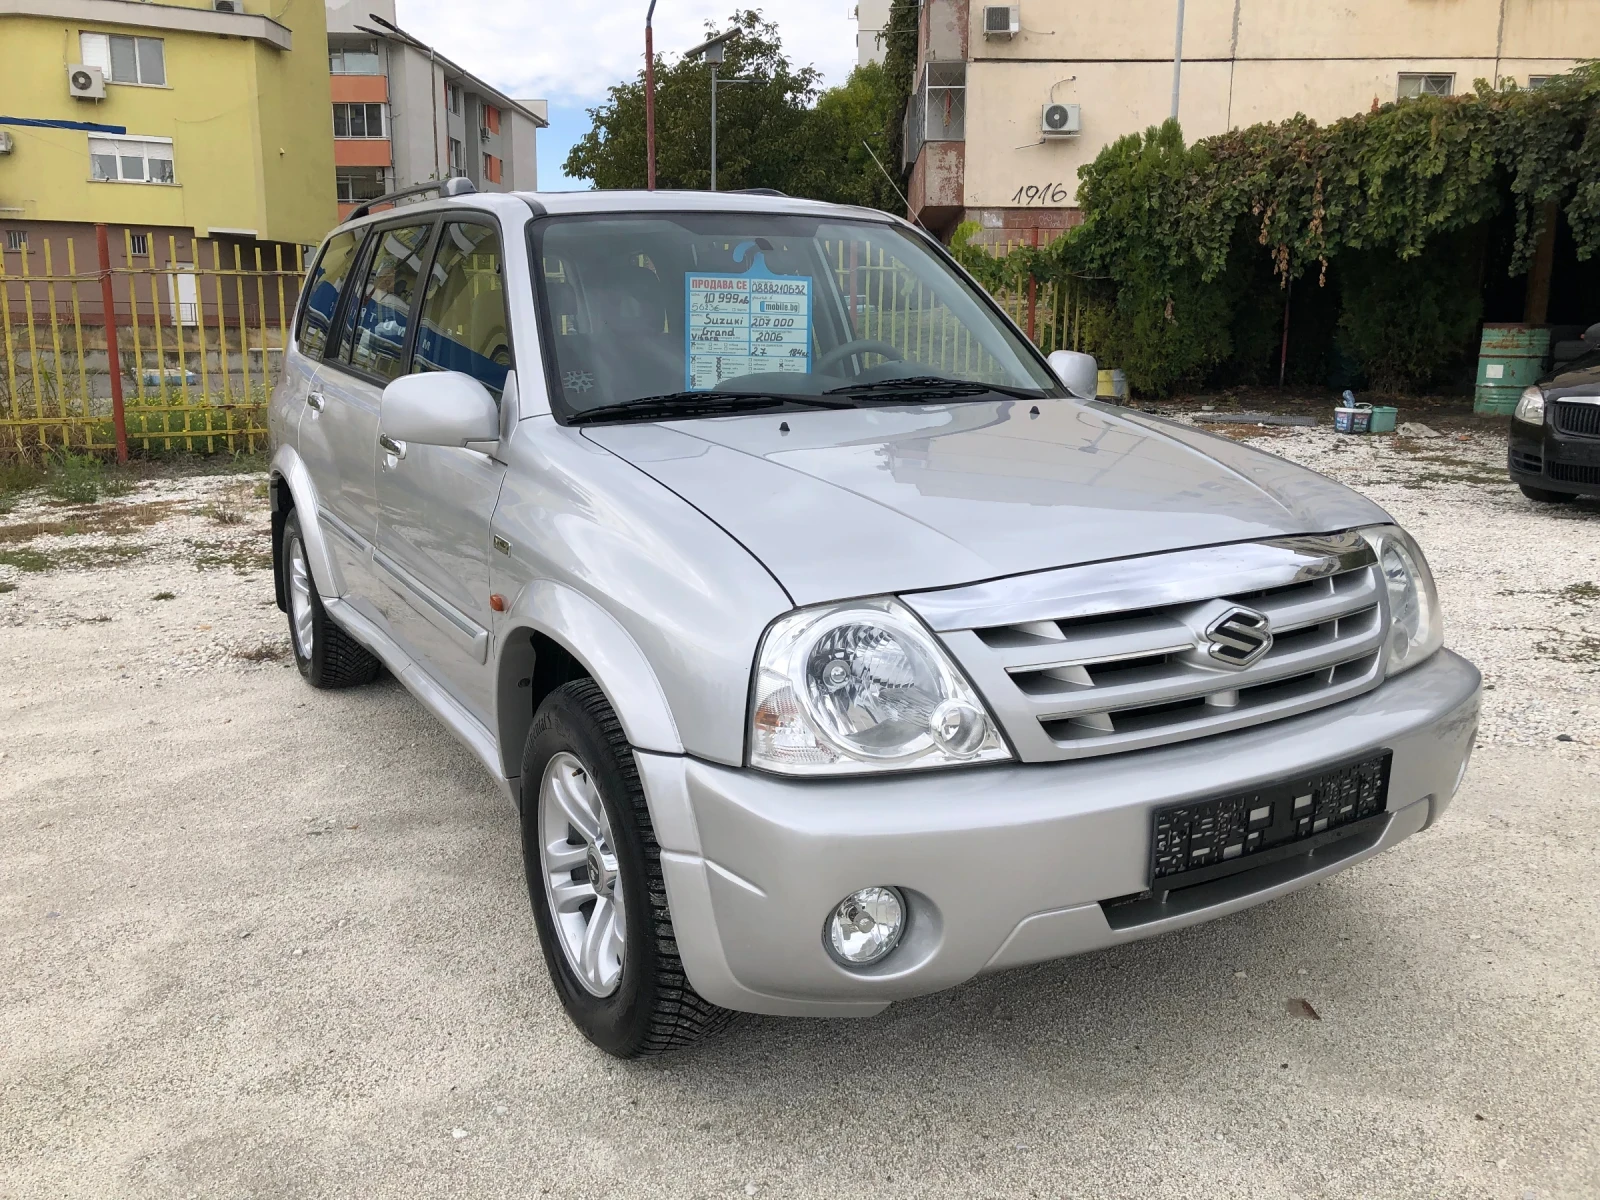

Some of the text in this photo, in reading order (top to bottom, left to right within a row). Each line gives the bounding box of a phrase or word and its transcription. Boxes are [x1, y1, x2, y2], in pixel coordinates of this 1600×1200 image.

[1011, 182, 1068, 206] 1916
[691, 279, 748, 290] ПРОДАВА СЕ
[751, 283, 806, 295] 0888210632
[704, 292, 715, 304] 10
[765, 302, 799, 313] mobile.bg
[703, 313, 744, 325] Suzuki
[751, 317, 795, 328] 207 000
[701, 326, 735, 337] Grand
[755, 332, 784, 342] 2006
